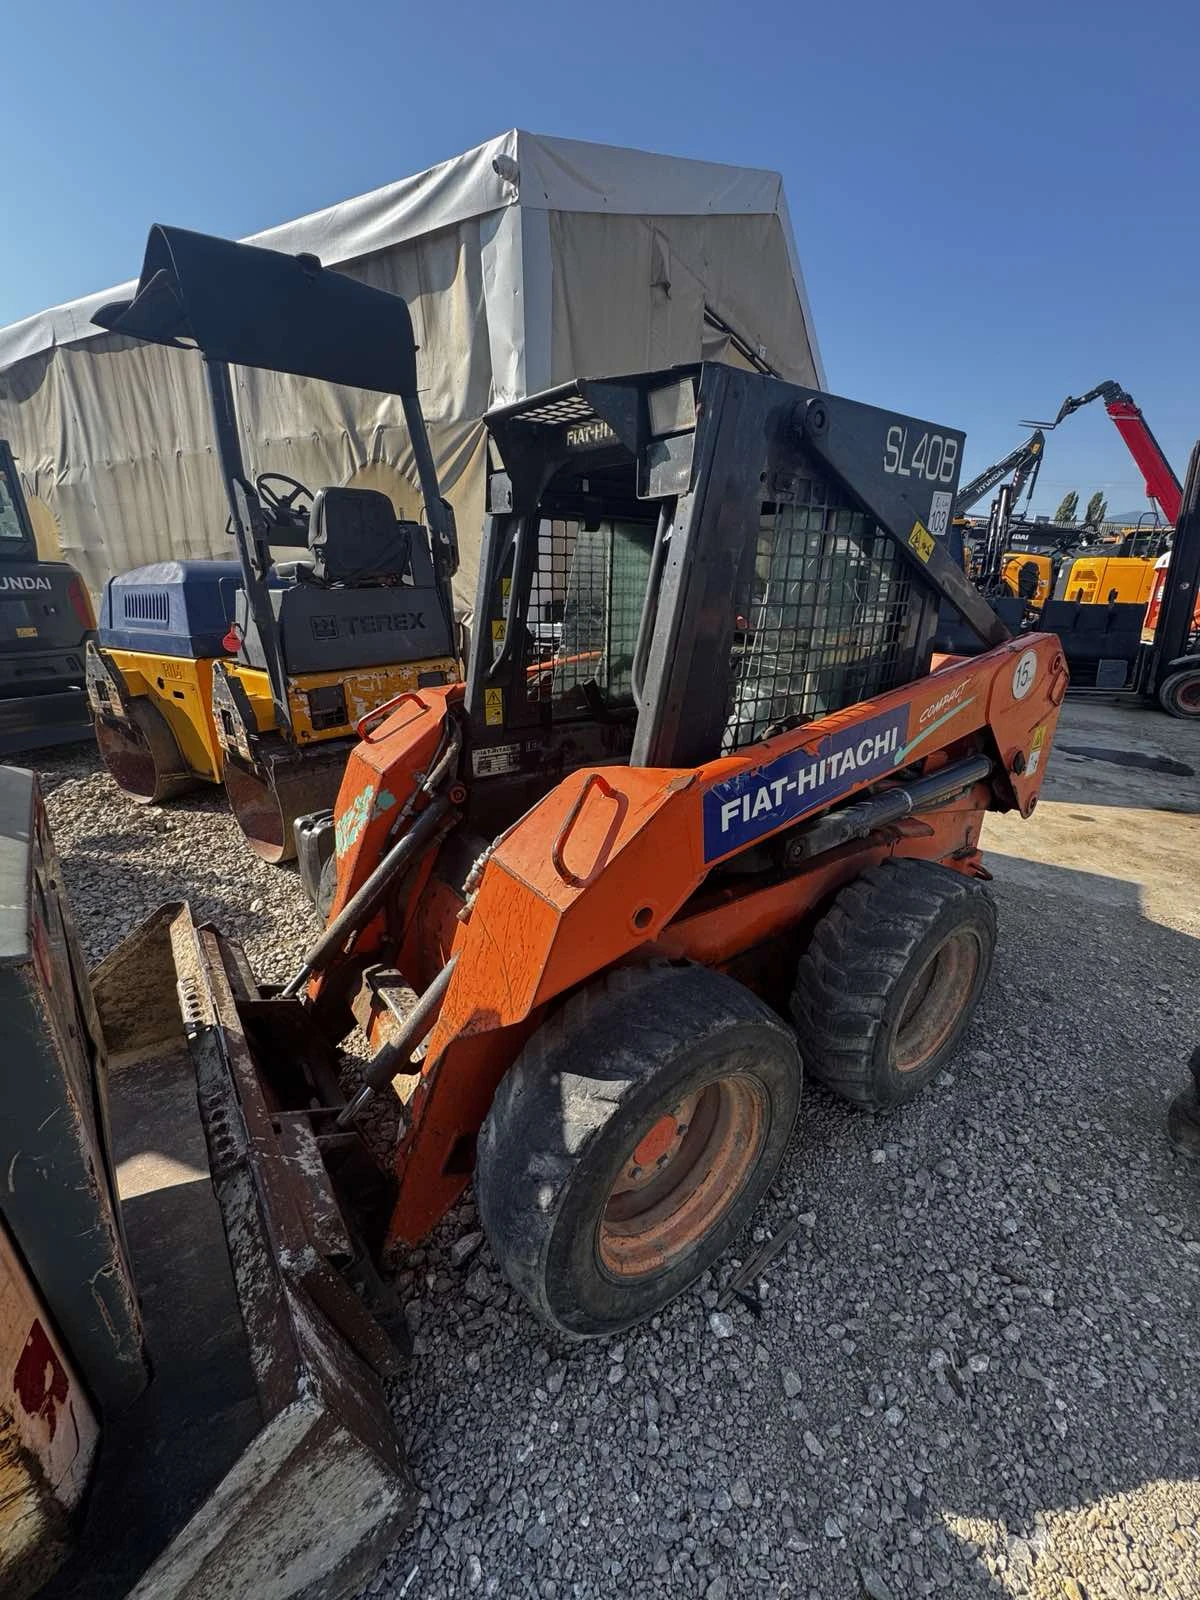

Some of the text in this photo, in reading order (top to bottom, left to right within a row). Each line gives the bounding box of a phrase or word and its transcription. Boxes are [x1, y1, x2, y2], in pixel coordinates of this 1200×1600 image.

[884, 426, 958, 483] SL40B
[976, 468, 1006, 494] HYUNDAI
[930, 511, 947, 532] 103
[342, 612, 426, 636] TEREX
[1016, 660, 1030, 689] 15
[919, 678, 971, 723] COMPACT
[721, 727, 897, 833] FIAT-HITACHI
